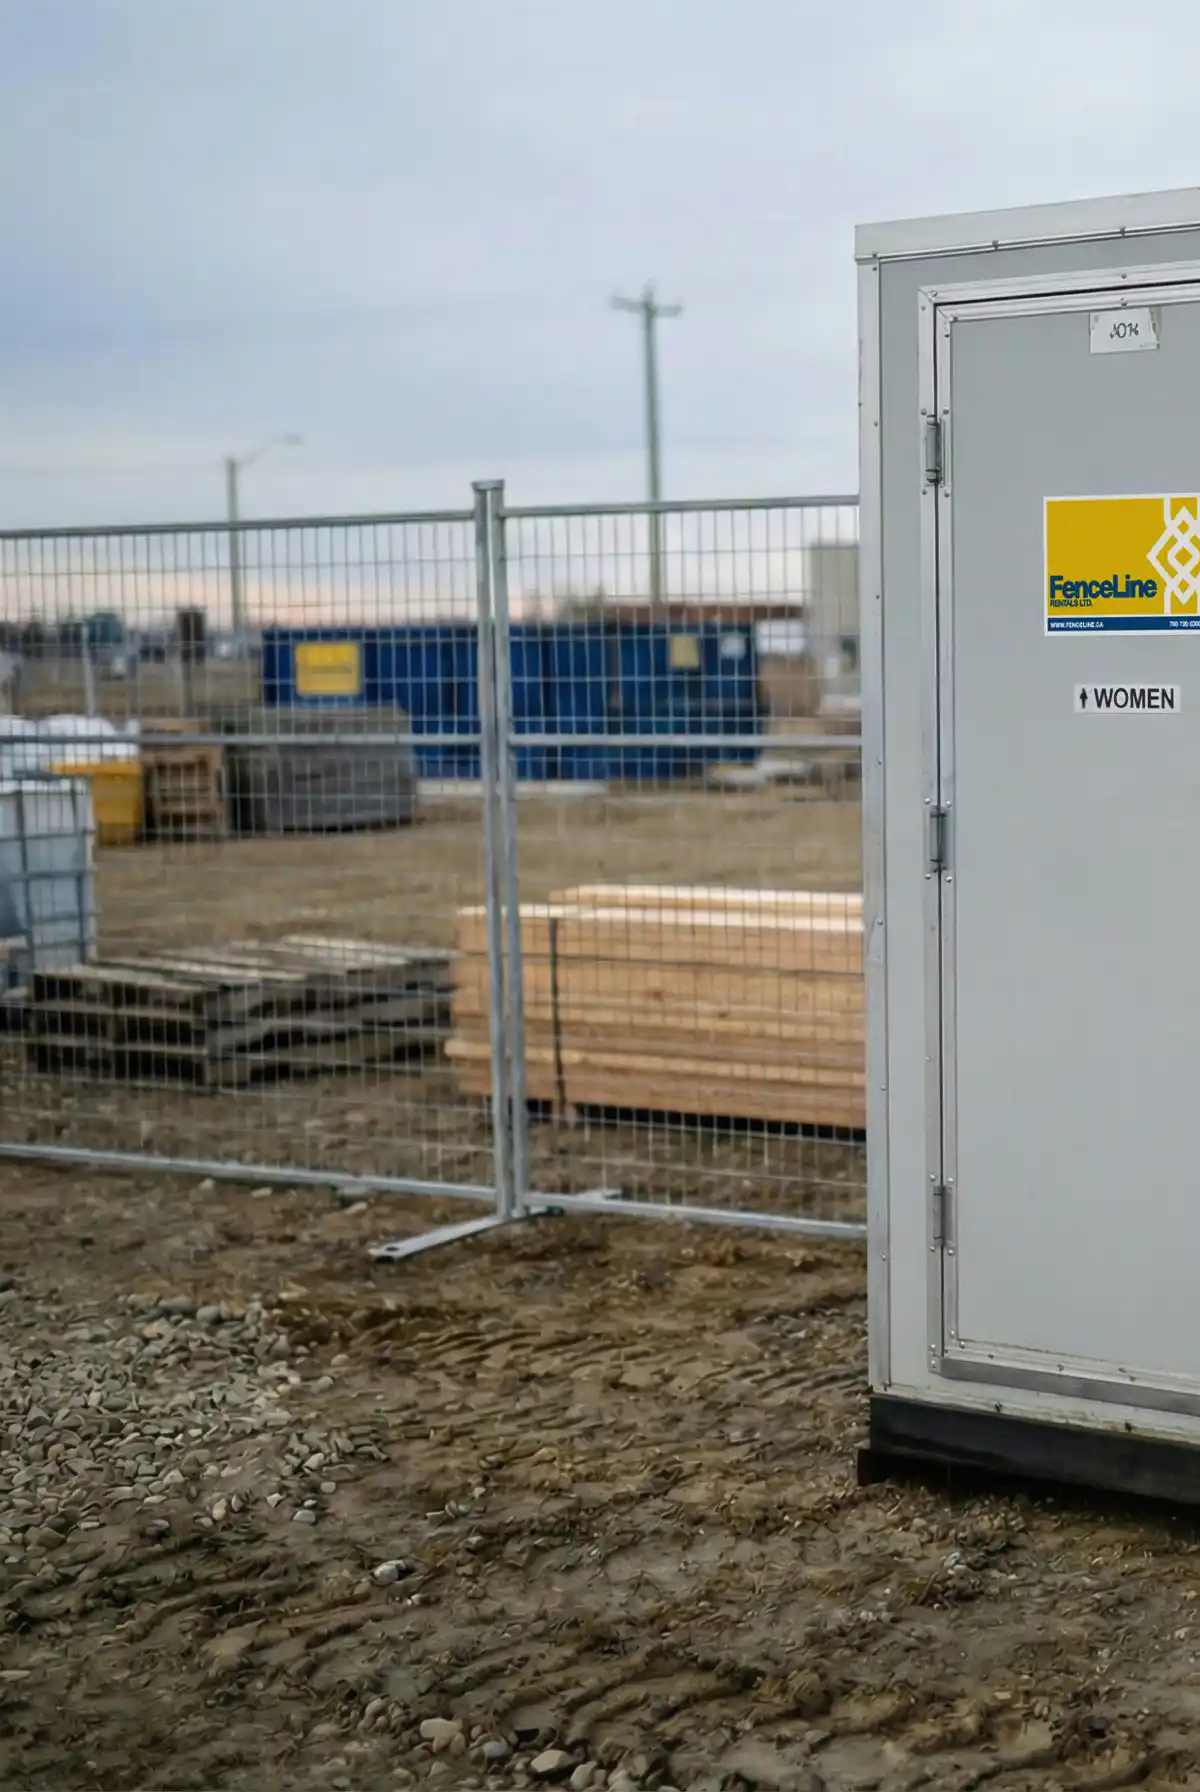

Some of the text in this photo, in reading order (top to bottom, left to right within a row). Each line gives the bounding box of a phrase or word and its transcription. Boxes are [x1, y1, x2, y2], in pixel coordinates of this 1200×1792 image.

[1050, 574, 1157, 599] FenceLine
[1050, 599, 1079, 607] RENTALS
[1094, 687, 1174, 709] WOMEN
